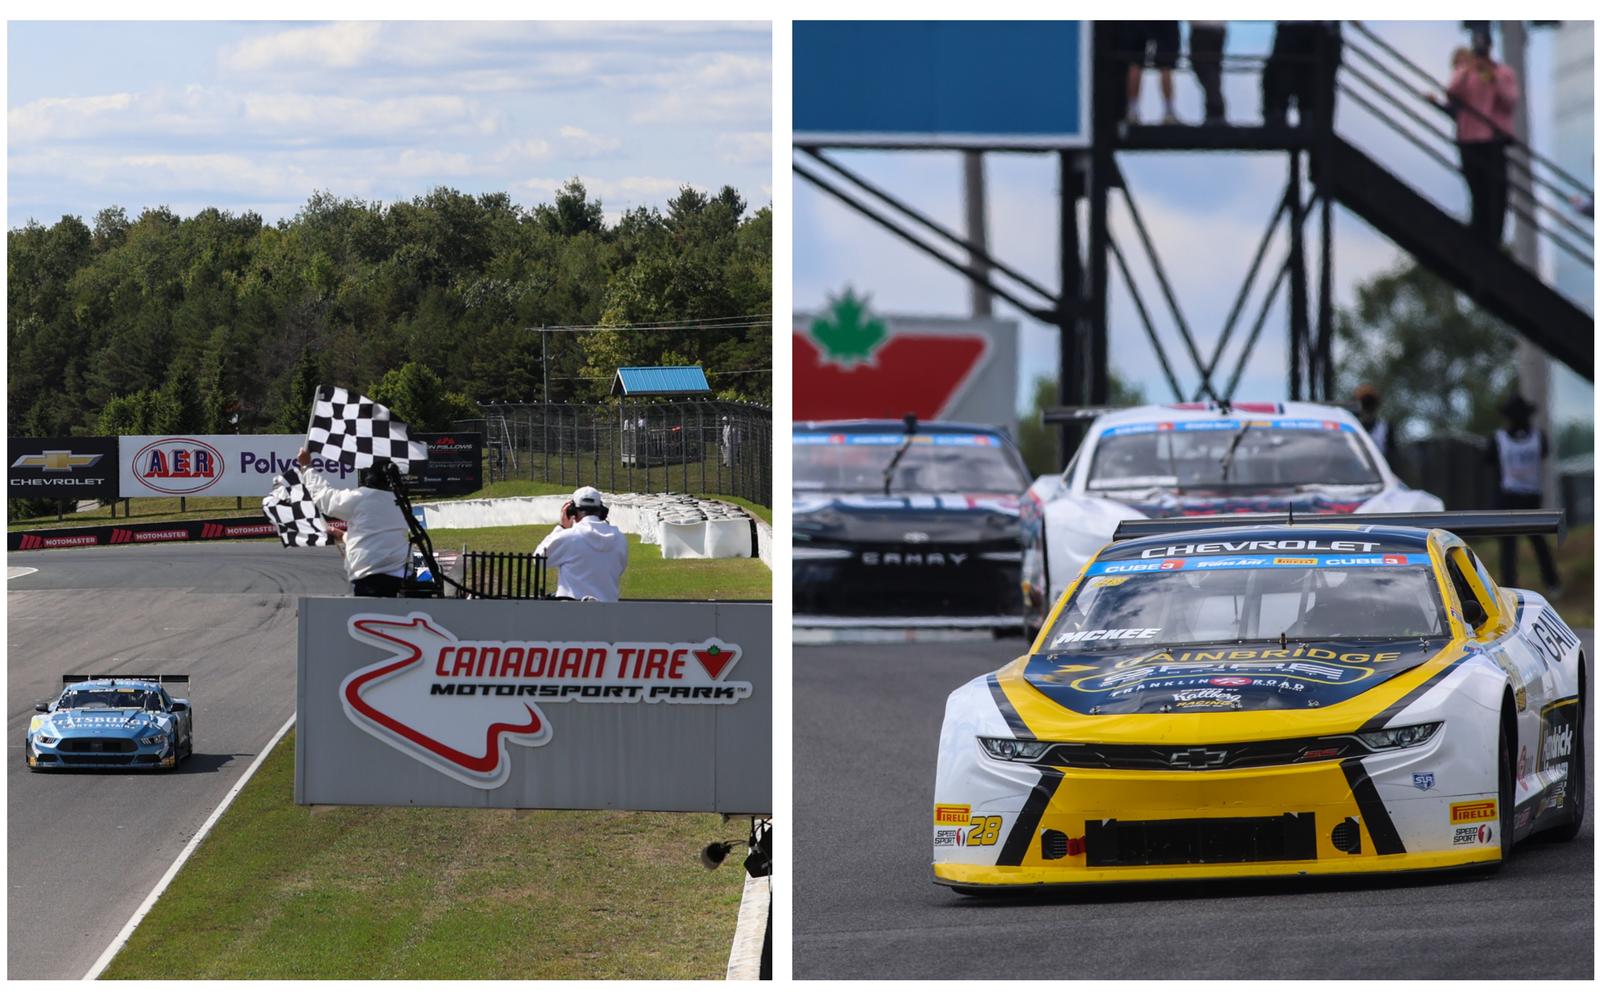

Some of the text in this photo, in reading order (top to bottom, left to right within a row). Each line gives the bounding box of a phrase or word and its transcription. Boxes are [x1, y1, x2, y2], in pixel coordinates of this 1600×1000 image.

[143, 449, 214, 478] AER
[10, 478, 104, 486] CHEVROLET
[45, 537, 96, 546] MOTOMASTER
[136, 531, 186, 540] MOTOMASTER
[1141, 540, 1380, 559] CHEVROLET
[862, 552, 969, 565] CAMRY
[1056, 628, 1162, 645] MCKEE
[435, 646, 689, 680] CANADIAN TIRE
[430, 683, 643, 698] MOTORSPORT
[650, 686, 735, 699] PARK
[1110, 678, 1209, 698] FRANKLIN
[1252, 679, 1305, 692] ROAD
[936, 807, 969, 822] PIRELLI
[966, 815, 1003, 846] 28
[1456, 827, 1478, 836] SPEED
[935, 837, 955, 845] SPORT
[1453, 835, 1476, 843] SPORT
